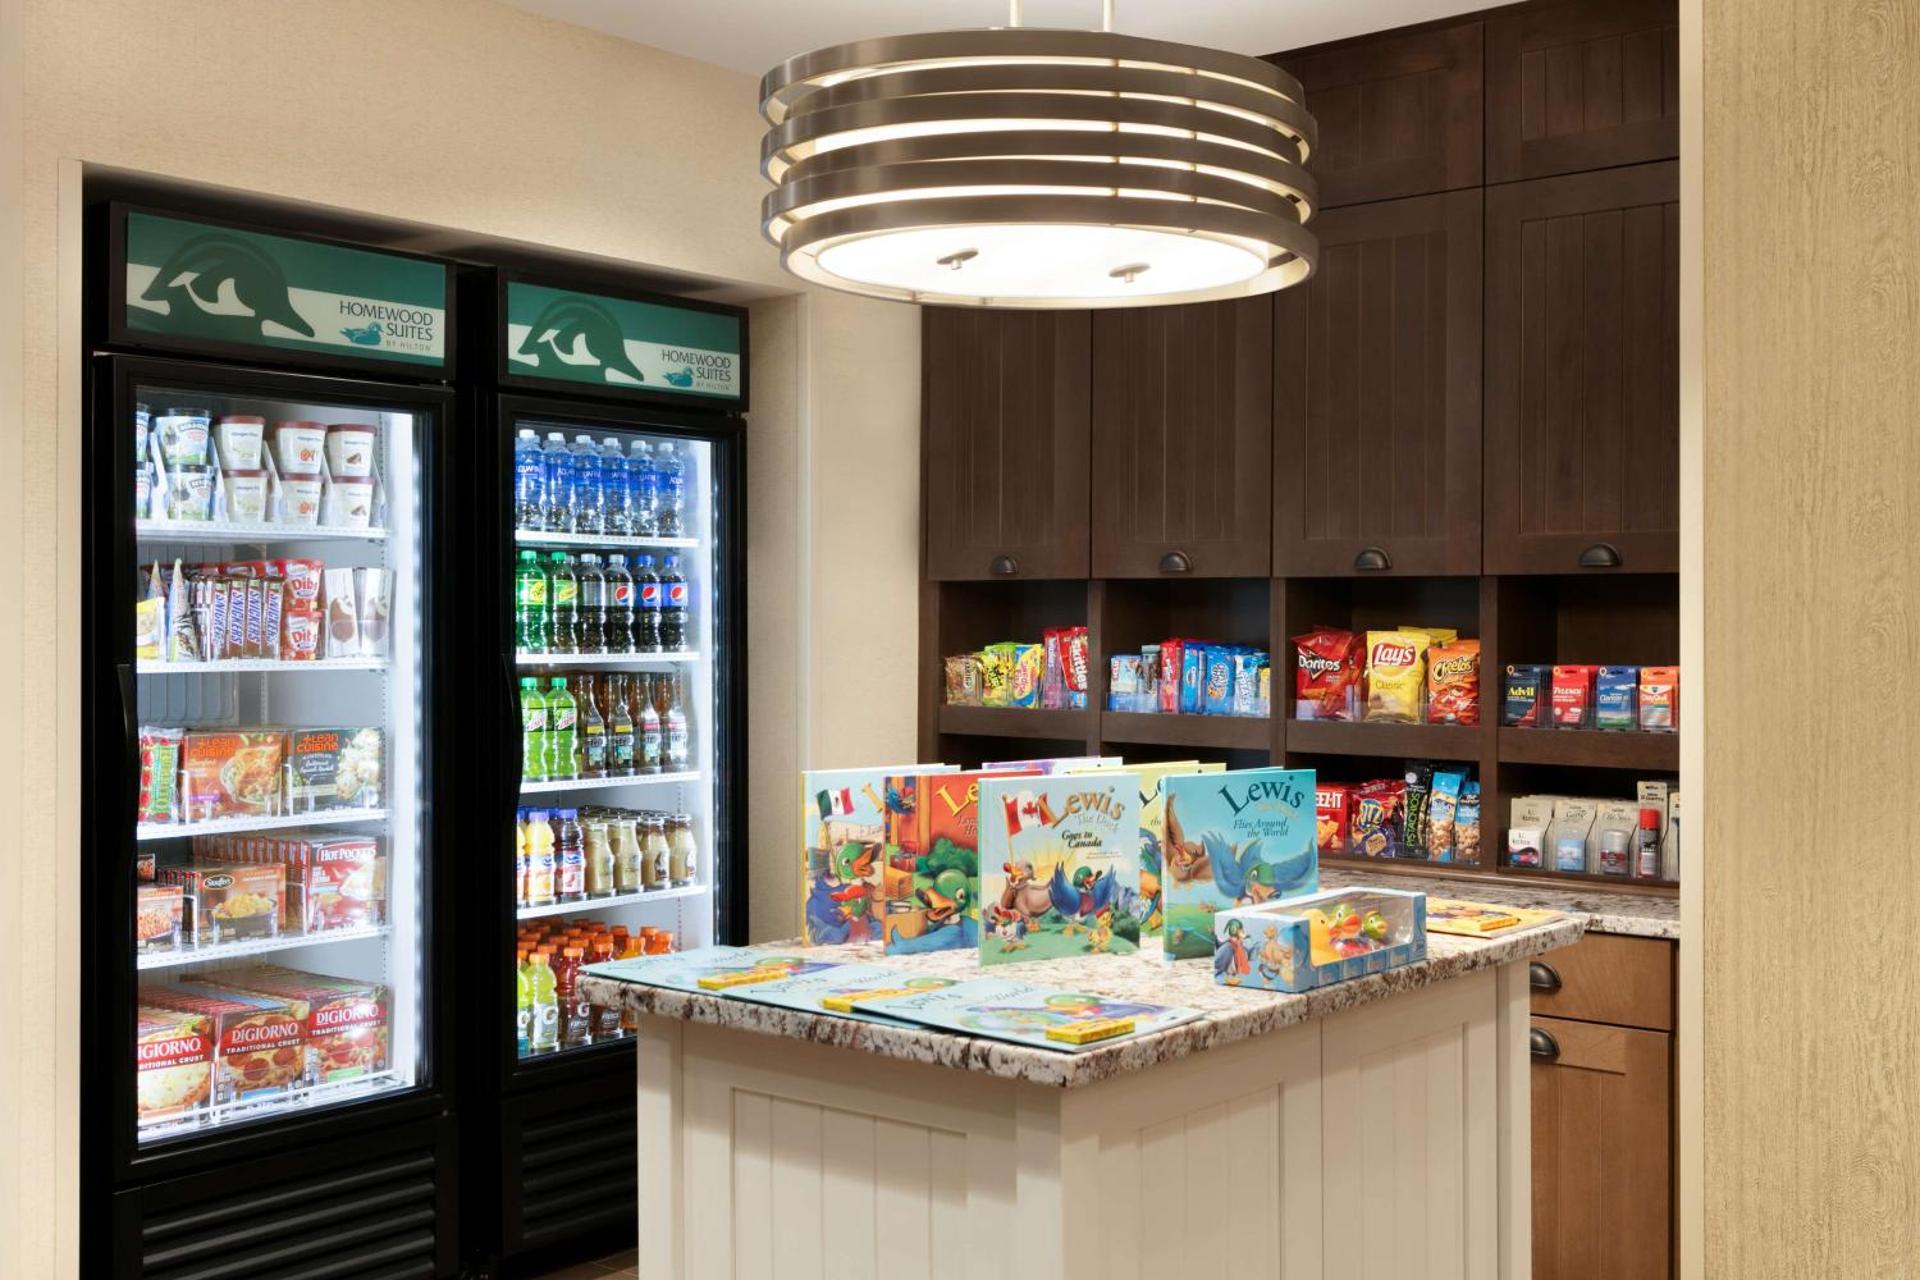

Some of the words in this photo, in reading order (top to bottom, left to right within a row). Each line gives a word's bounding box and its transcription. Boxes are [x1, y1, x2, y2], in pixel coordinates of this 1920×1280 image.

[340, 300, 433, 326] HOMEWOOD
[386, 322, 433, 341] SUITES
[662, 349, 731, 369] HOMEWOOD
[696, 366, 731, 382] SUITES
[231, 591, 244, 644] SNICKERS
[1298, 654, 1341, 671] Doritos
[1508, 686, 1535, 697] Advil
[1038, 785, 1126, 829] Lewis
[1218, 775, 1305, 818] Lewis
[1406, 793, 1420, 847] PISTACHIOS
[1068, 836, 1102, 848] Canada
[316, 1004, 379, 1026] DIGIORNO
[231, 1022, 299, 1044] DIGIORNO
[138, 1037, 202, 1060] IGIORNO
[226, 1043, 275, 1054] TRADITIONAL
[278, 1038, 300, 1047] CRUST
[178, 1054, 204, 1064] CRUST
